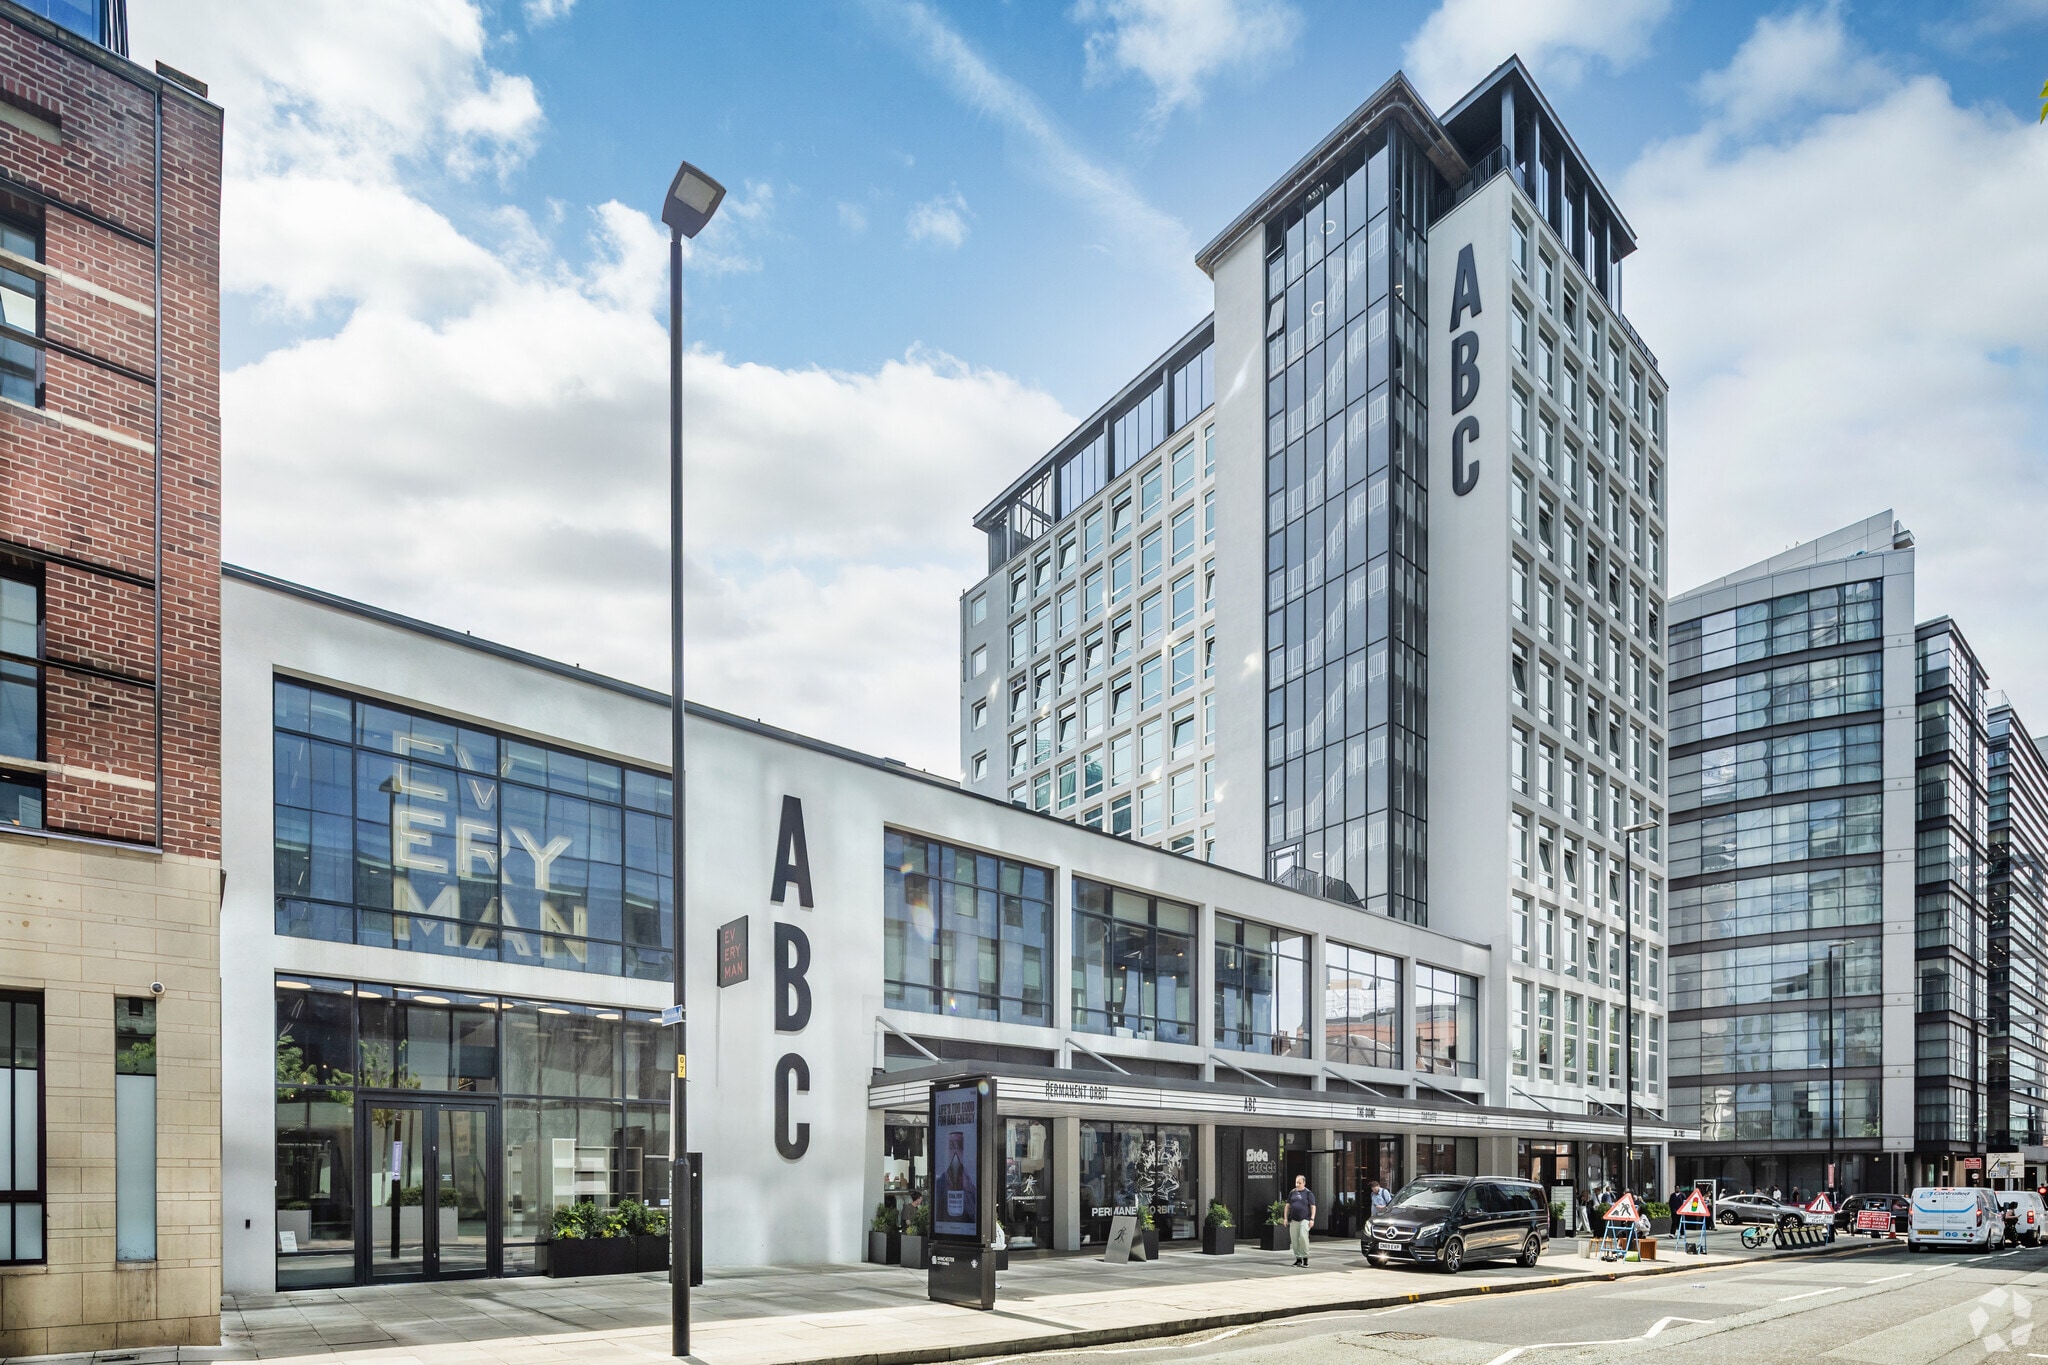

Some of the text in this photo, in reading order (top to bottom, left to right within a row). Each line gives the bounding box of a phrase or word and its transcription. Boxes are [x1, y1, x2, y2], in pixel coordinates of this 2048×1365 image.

[1449, 243, 1482, 497] ABC
[393, 803, 573, 891] ERY
[393, 875, 588, 964] MAN
[724, 928, 736, 944] EV
[724, 943, 741, 962] ERY
[724, 960, 743, 979] MAN
[770, 794, 814, 1161] ABC
[1045, 1082, 1109, 1101] PERMANENT ORBIT
[938, 1103, 951, 1115] LIFE'S
[951, 1102, 961, 1114] TOO
[1243, 1097, 1257, 1112] ABC
[1247, 1160, 1277, 1174] street
[1091, 1206, 1138, 1217] PERMANE
